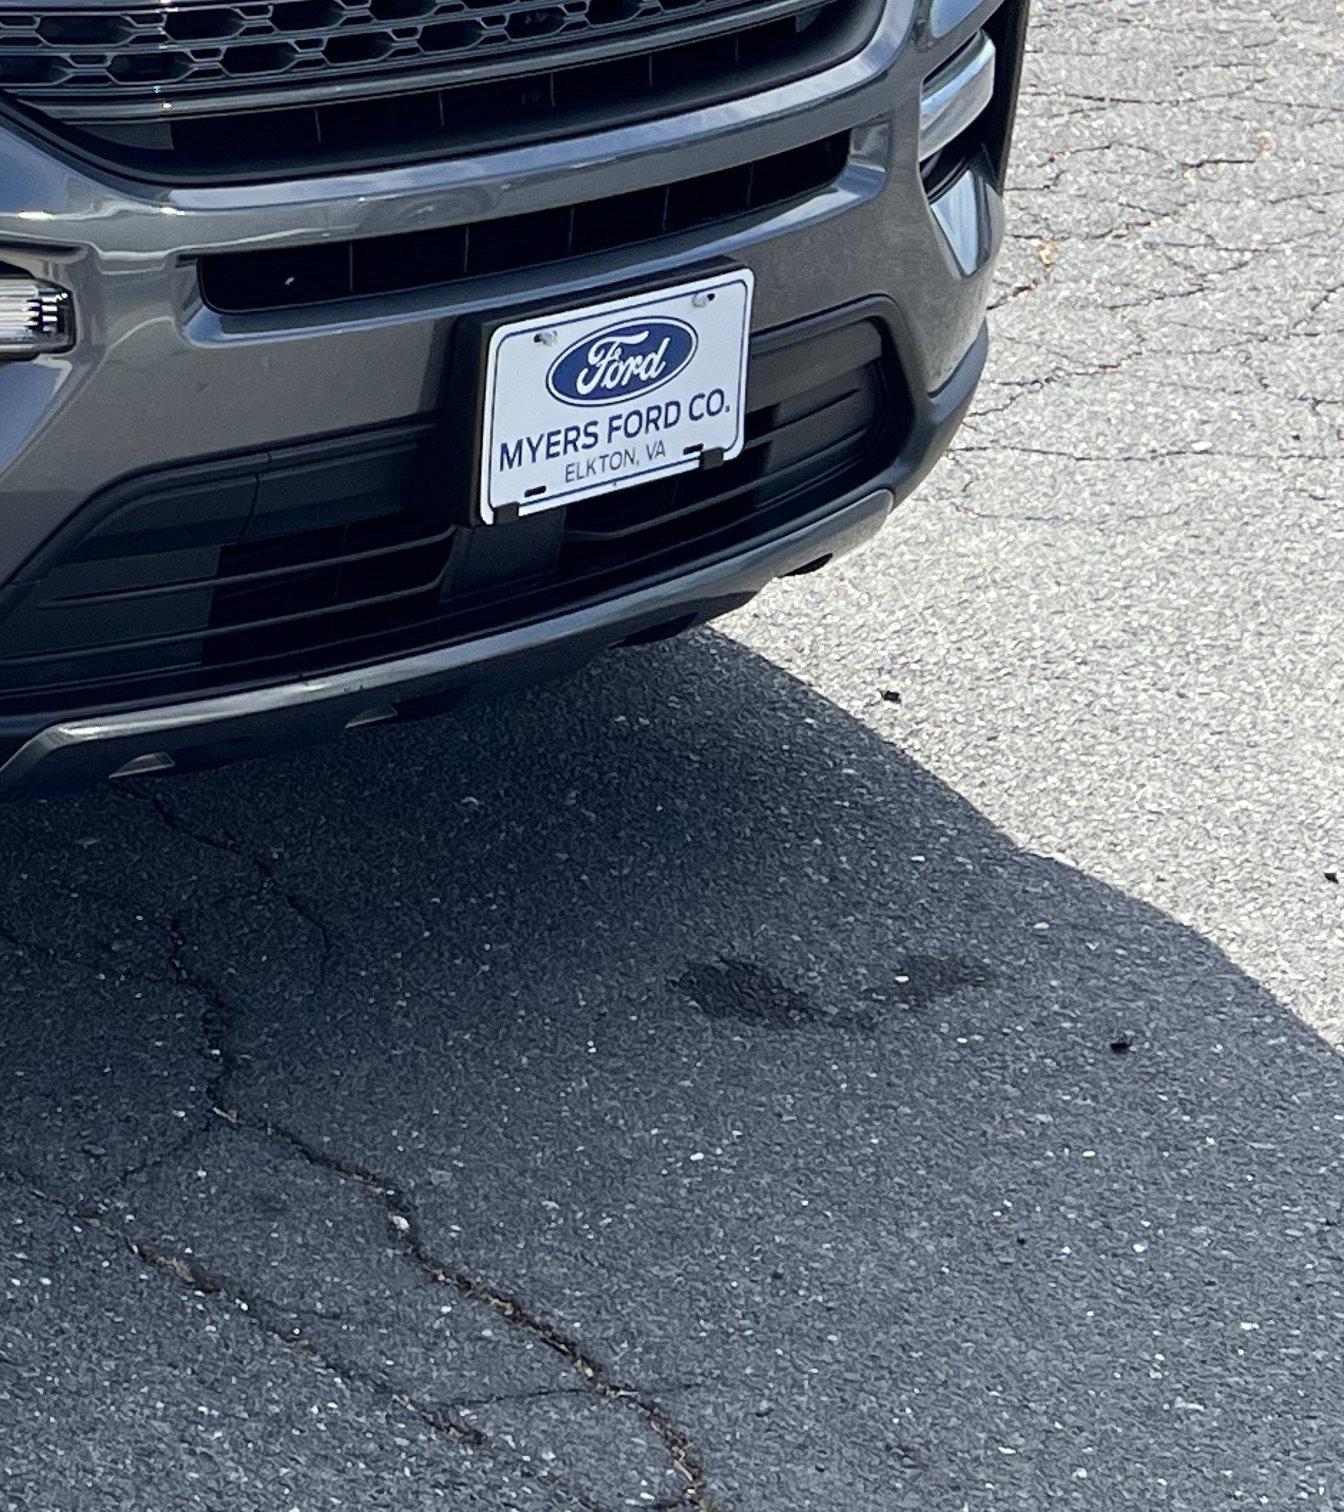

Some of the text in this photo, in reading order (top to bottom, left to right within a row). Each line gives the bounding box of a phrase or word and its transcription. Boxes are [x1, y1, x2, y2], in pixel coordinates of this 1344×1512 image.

[576, 330, 671, 395] Ford
[499, 388, 731, 472] MYERS FORD CO.
[565, 439, 667, 484] ELKTON, VA
